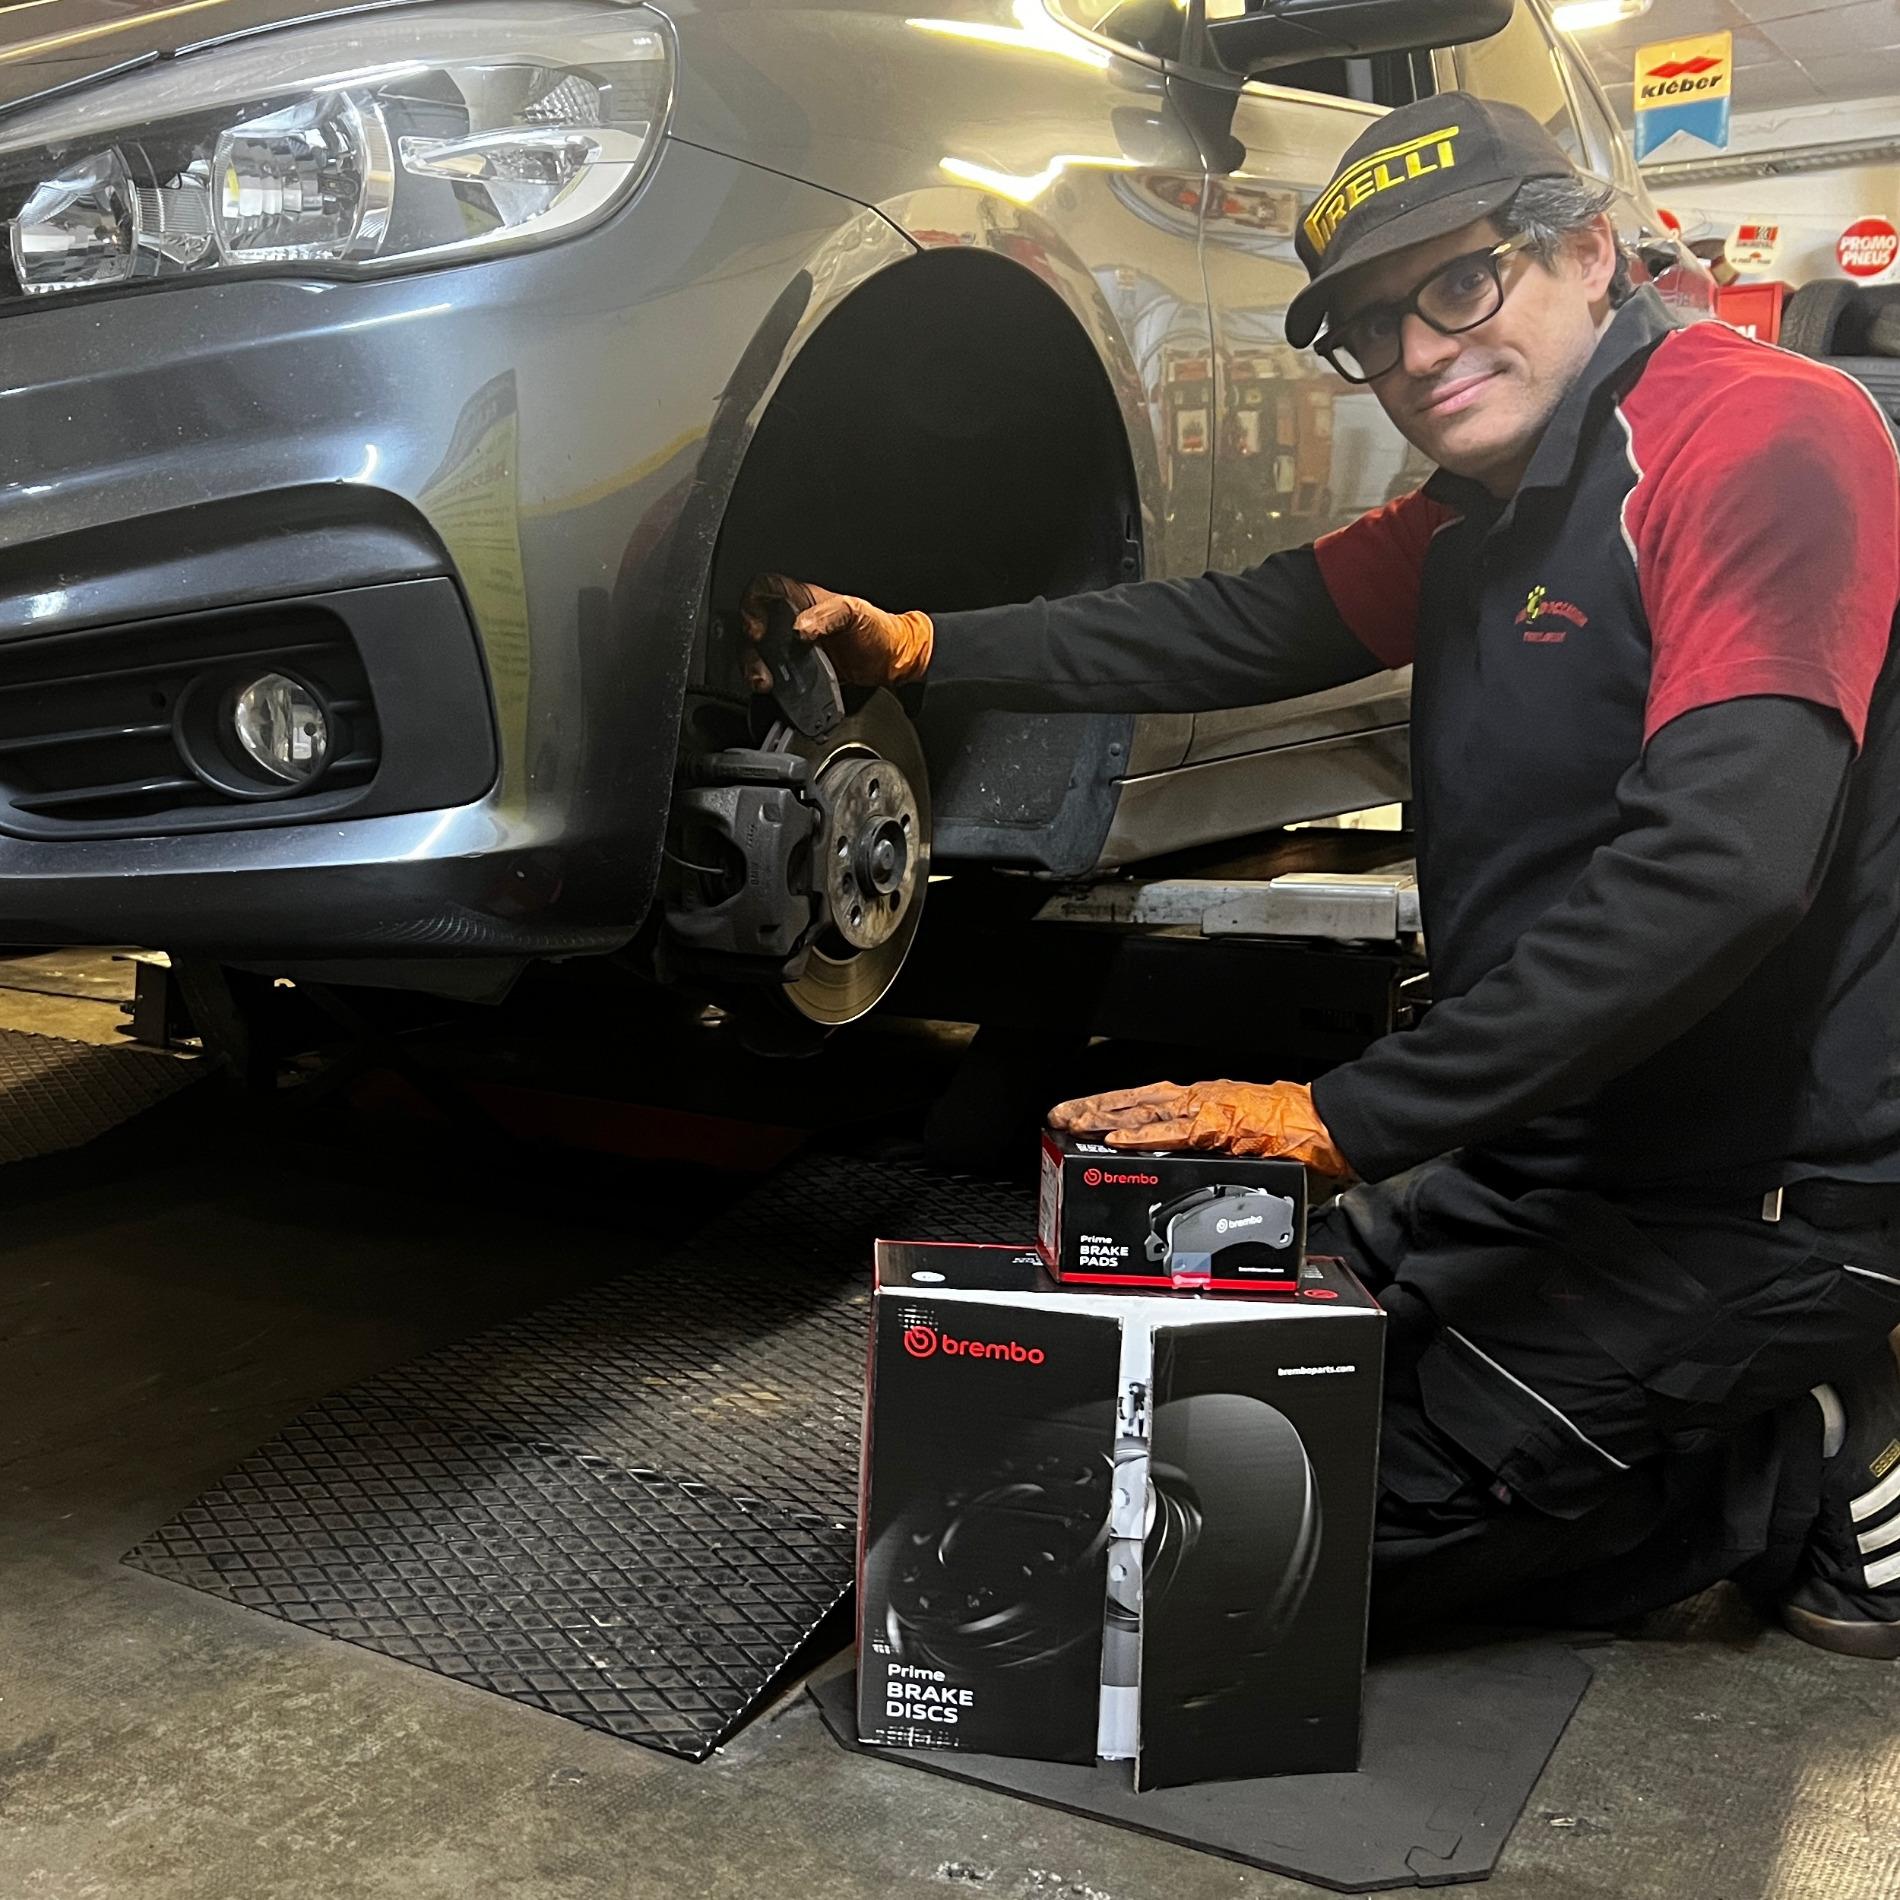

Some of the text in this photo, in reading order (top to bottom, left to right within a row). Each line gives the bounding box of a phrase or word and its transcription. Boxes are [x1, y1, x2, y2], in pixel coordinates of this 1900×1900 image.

[1303, 126, 1459, 256] PIRELLI
[1840, 235, 1897, 251] PROMO
[1841, 250, 1891, 266] PNEUS
[1104, 1172, 1158, 1185] brembo
[1228, 1216, 1263, 1229] brembo
[1080, 1235, 1113, 1244] Prime
[1080, 1245, 1129, 1256] BRAKE
[1080, 1256, 1119, 1267] PADS
[942, 1334, 1044, 1364] brembo
[887, 1663, 946, 1682] Prime
[887, 1681, 974, 1707] BRAKE
[886, 1700, 959, 1724] DISCS
